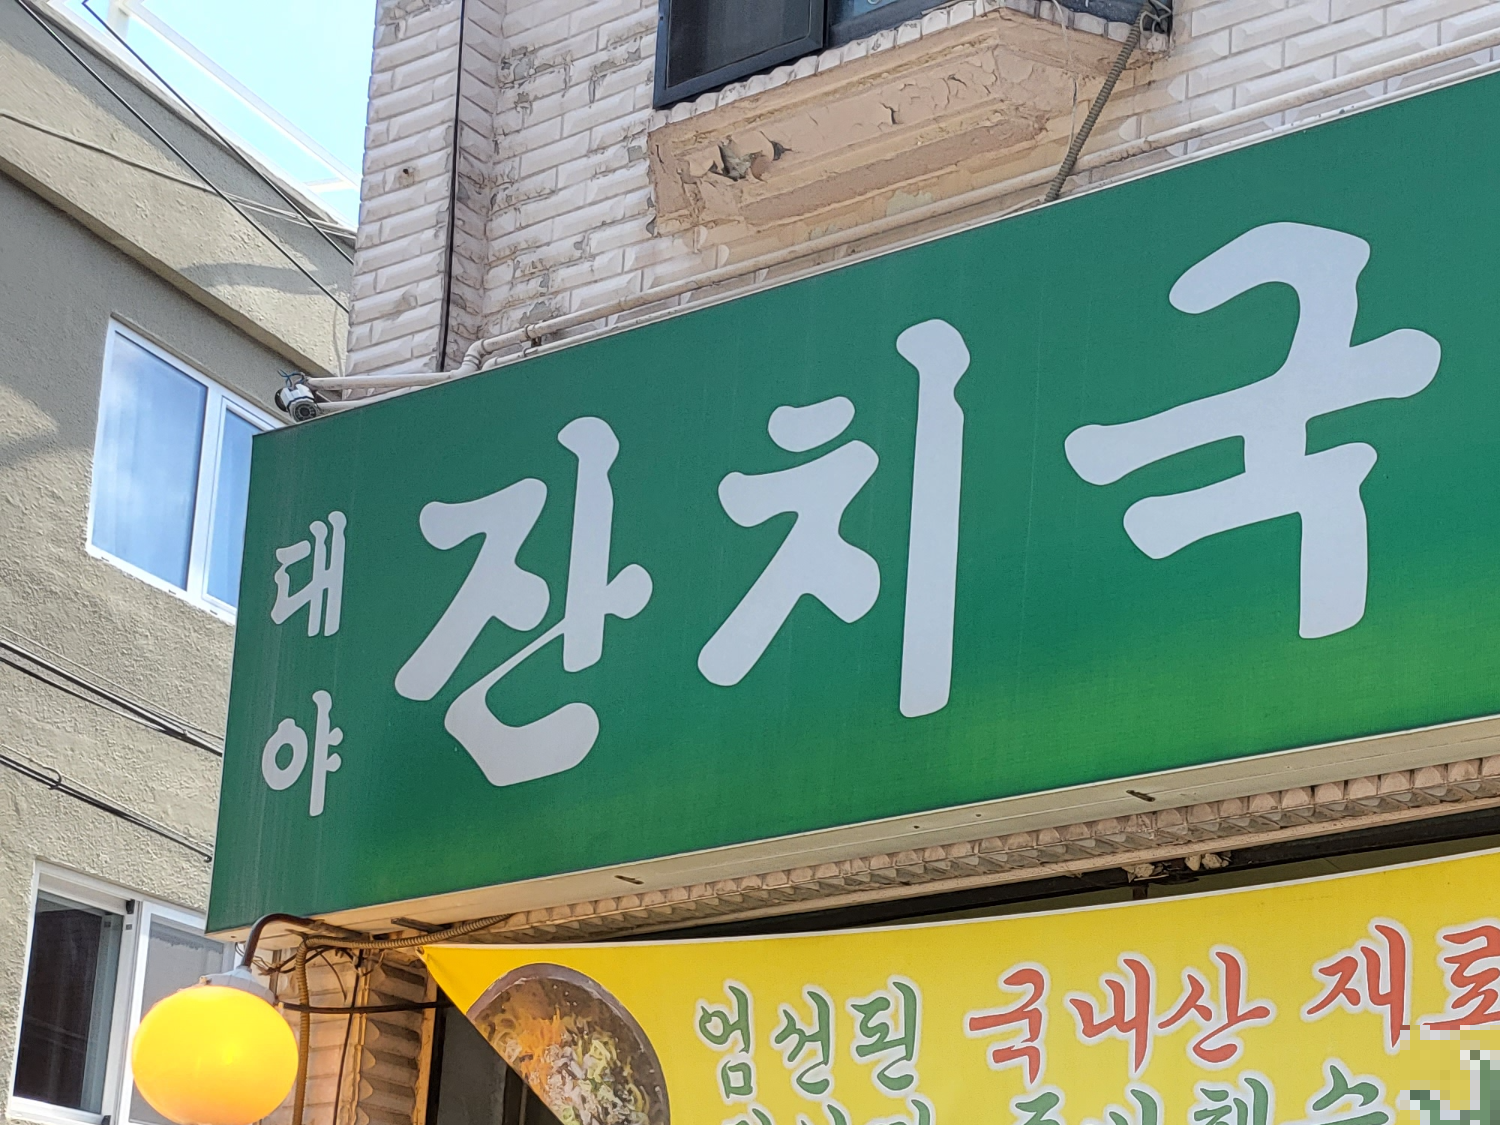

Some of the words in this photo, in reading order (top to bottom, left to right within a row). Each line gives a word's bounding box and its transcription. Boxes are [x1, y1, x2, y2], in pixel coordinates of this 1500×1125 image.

[260, 510, 348, 817] 대야
[697, 979, 920, 1101] 엄선된
[966, 956, 1272, 1064] 국내산
